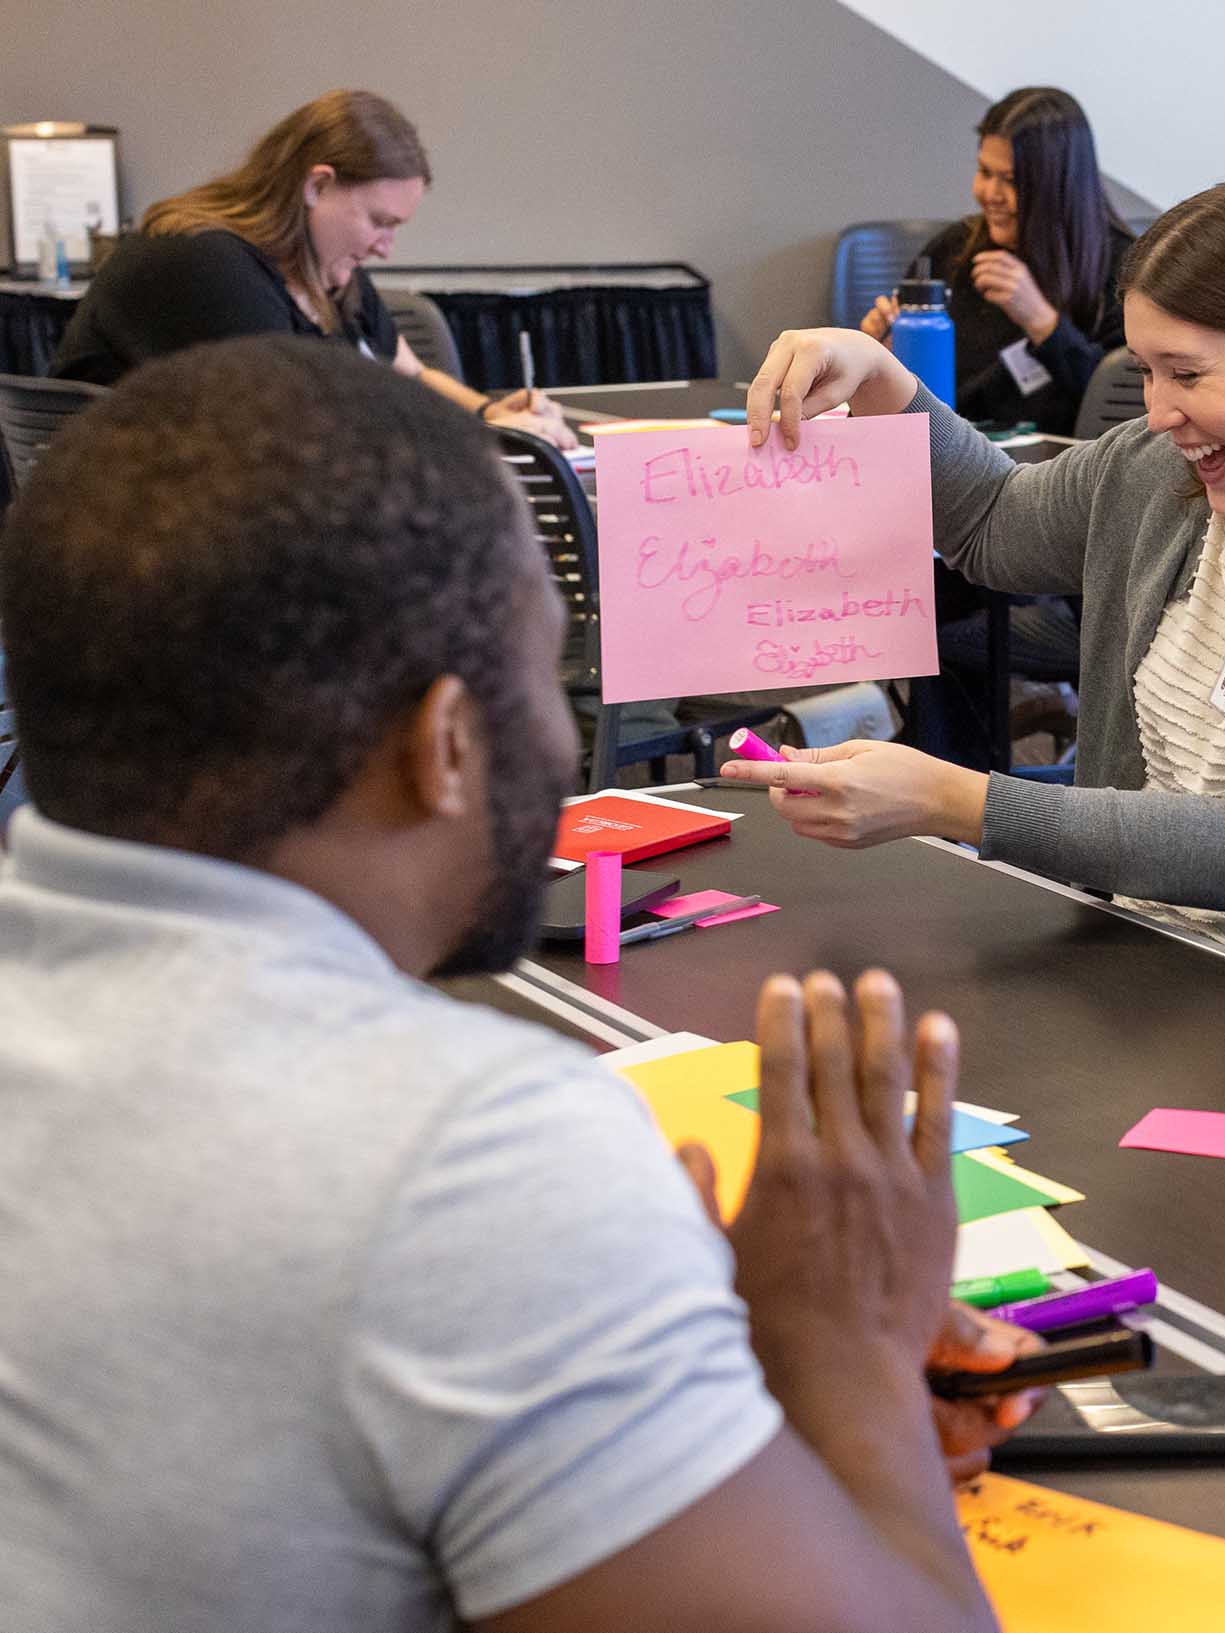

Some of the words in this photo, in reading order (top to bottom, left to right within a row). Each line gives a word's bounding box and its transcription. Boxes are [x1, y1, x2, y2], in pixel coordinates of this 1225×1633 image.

[641, 446, 861, 502] Elizabeth
[637, 536, 857, 622] Elizabeth
[747, 589, 928, 627] Elizabeth
